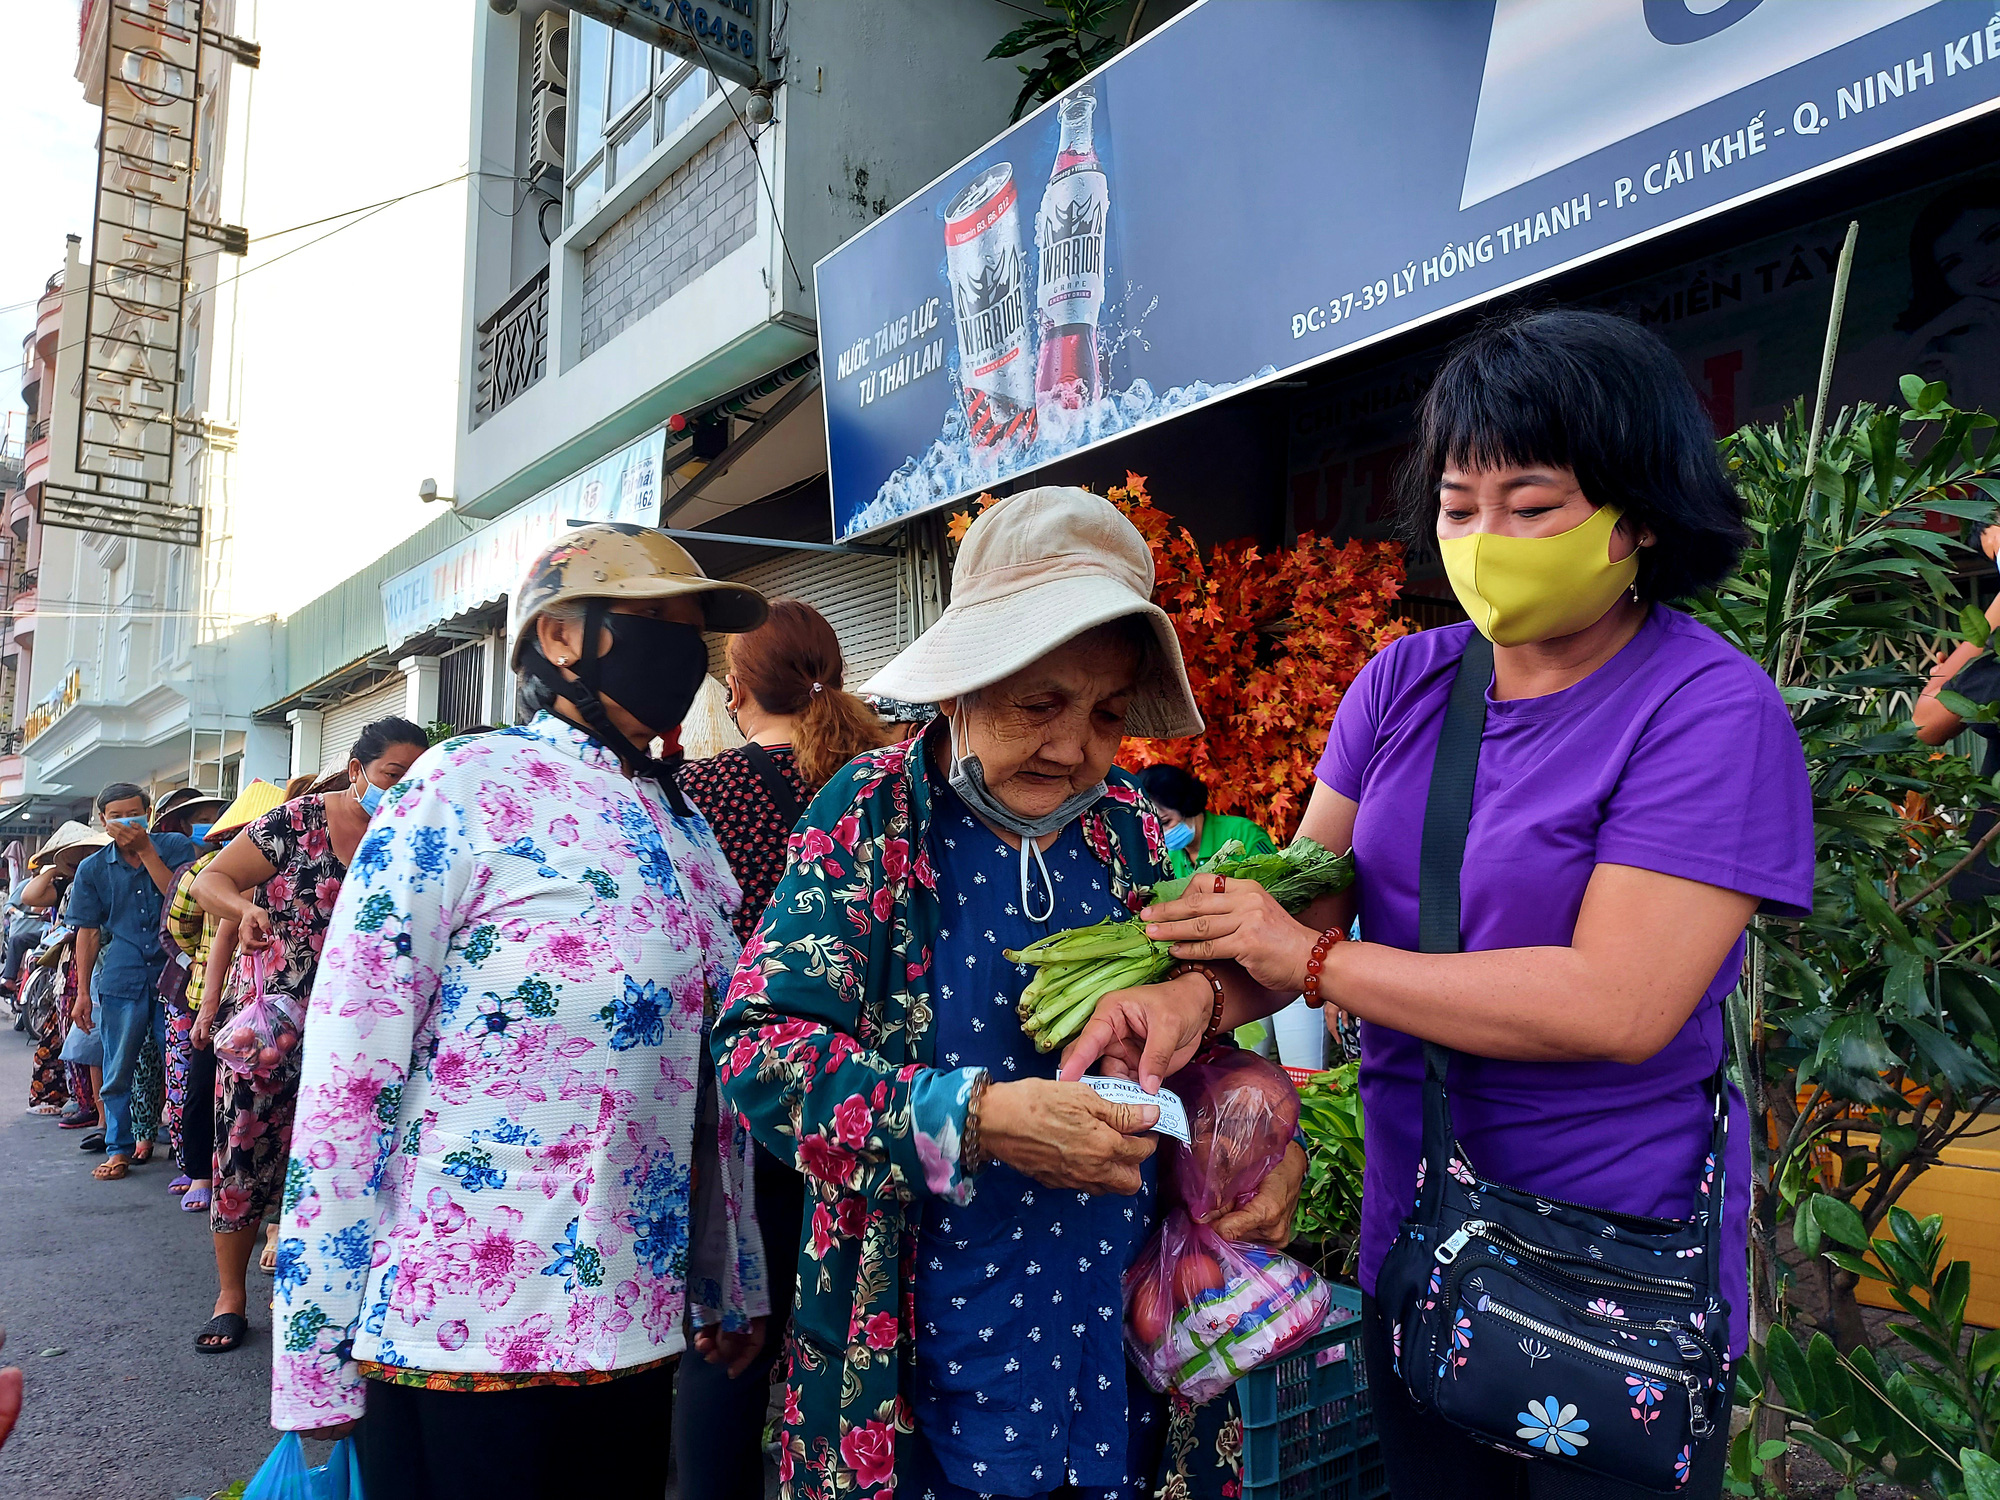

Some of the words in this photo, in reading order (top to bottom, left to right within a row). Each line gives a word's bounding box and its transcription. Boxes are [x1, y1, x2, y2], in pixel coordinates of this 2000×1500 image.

[1291, 307, 1327, 339] ĐC:
[1329, 280, 1388, 324] 37-39
[1392, 261, 1417, 299] LÝ
[1421, 234, 1494, 287] HỒNG
[1497, 193, 1592, 254] THANH
[1614, 177, 1637, 209] P.
[1643, 150, 1694, 195] CÁI
[1702, 109, 1767, 174] KHẾ
[1793, 101, 1829, 135] Q.
[1836, 51, 1934, 121] NINH
[954, 228, 977, 243] Vitamin
[997, 196, 1010, 215] B12
[1043, 236, 1101, 286] WARRIOR
[1755, 239, 1847, 294] TÂY
[1050, 292, 1071, 305] ENERGY
[1054, 280, 1087, 293] GRAPE
[837, 337, 871, 381] NƯỚC
[874, 315, 908, 359] TĂNG
[910, 297, 940, 339] LỰC
[961, 286, 1025, 356] WARRIOR
[859, 370, 876, 408] TỪ
[879, 352, 911, 397] THÁI
[912, 338, 944, 380] LAN
[977, 361, 998, 376] ENERGY
[1296, 401, 1342, 435] CHI
[385, 575, 430, 620] MOTEL
